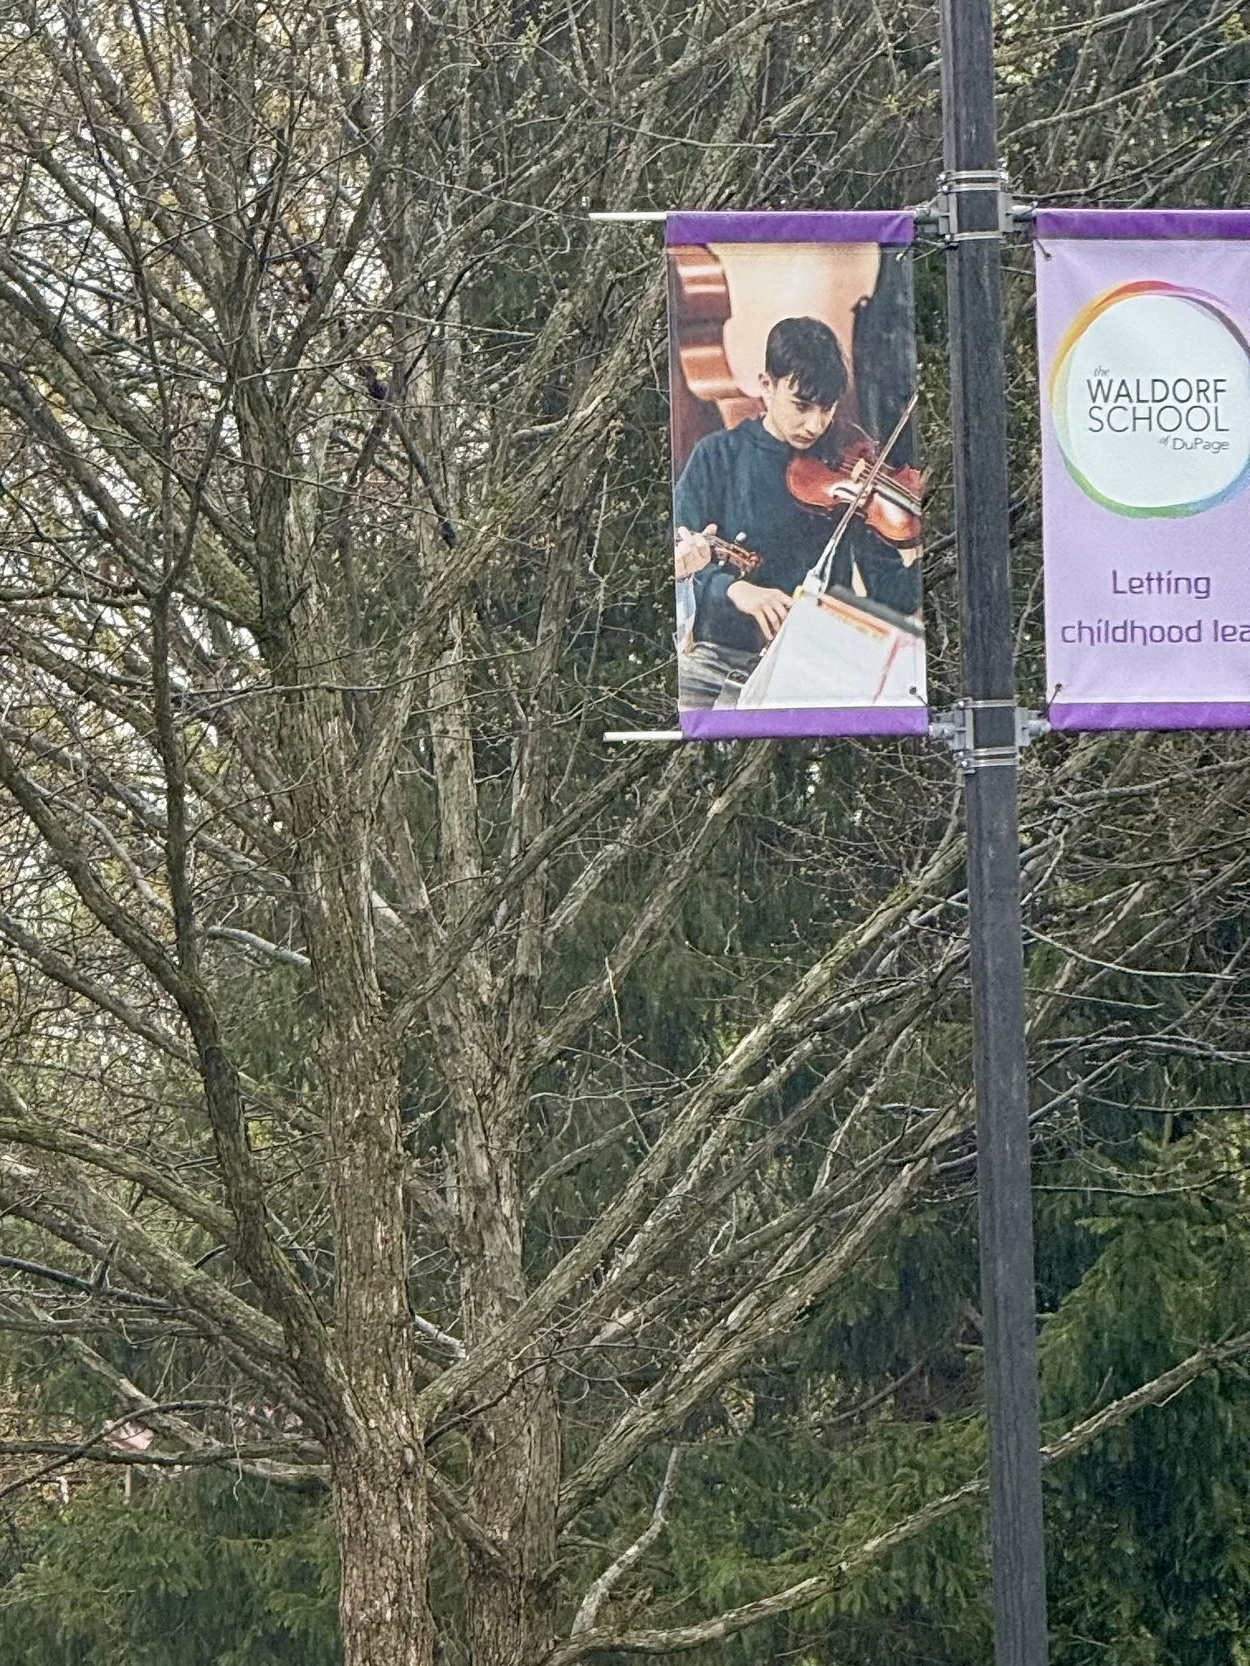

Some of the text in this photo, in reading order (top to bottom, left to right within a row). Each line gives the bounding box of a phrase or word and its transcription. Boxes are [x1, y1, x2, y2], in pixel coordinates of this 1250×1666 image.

[1093, 365, 1110, 377] the
[1086, 378, 1227, 403] WALDORF
[1088, 405, 1230, 432] SCHOOL
[1158, 434, 1230, 454] of DuPage
[1111, 569, 1211, 599] Letting
[1060, 619, 1202, 646] childhood
